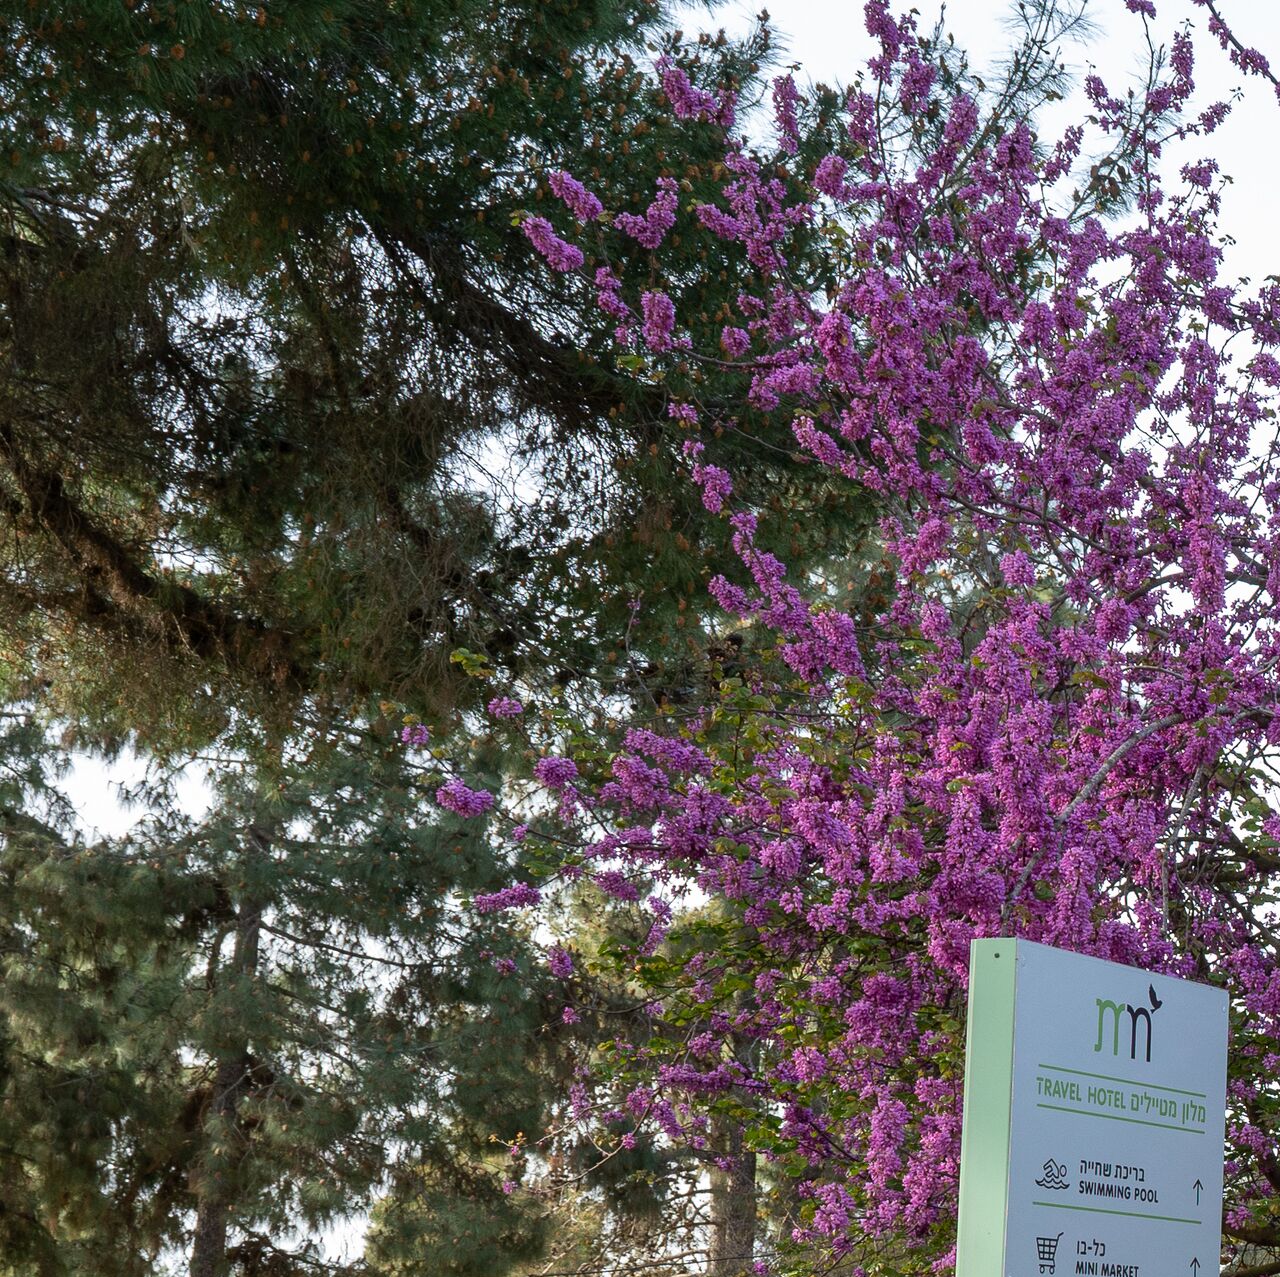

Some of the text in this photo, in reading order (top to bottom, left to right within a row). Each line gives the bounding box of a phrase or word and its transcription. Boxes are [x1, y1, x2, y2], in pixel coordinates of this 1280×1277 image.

[1037, 1077, 1126, 1109] TRAVEL HOTEL
[1131, 1092, 1205, 1124] מלון מטיילים
[1080, 1160, 1144, 1182] בריכת שחייה
[1079, 1181, 1158, 1203] SWIMMING POOL
[1077, 1239, 1105, 1256] כל-בו
[1076, 1261, 1139, 1277] MINI MARKET
